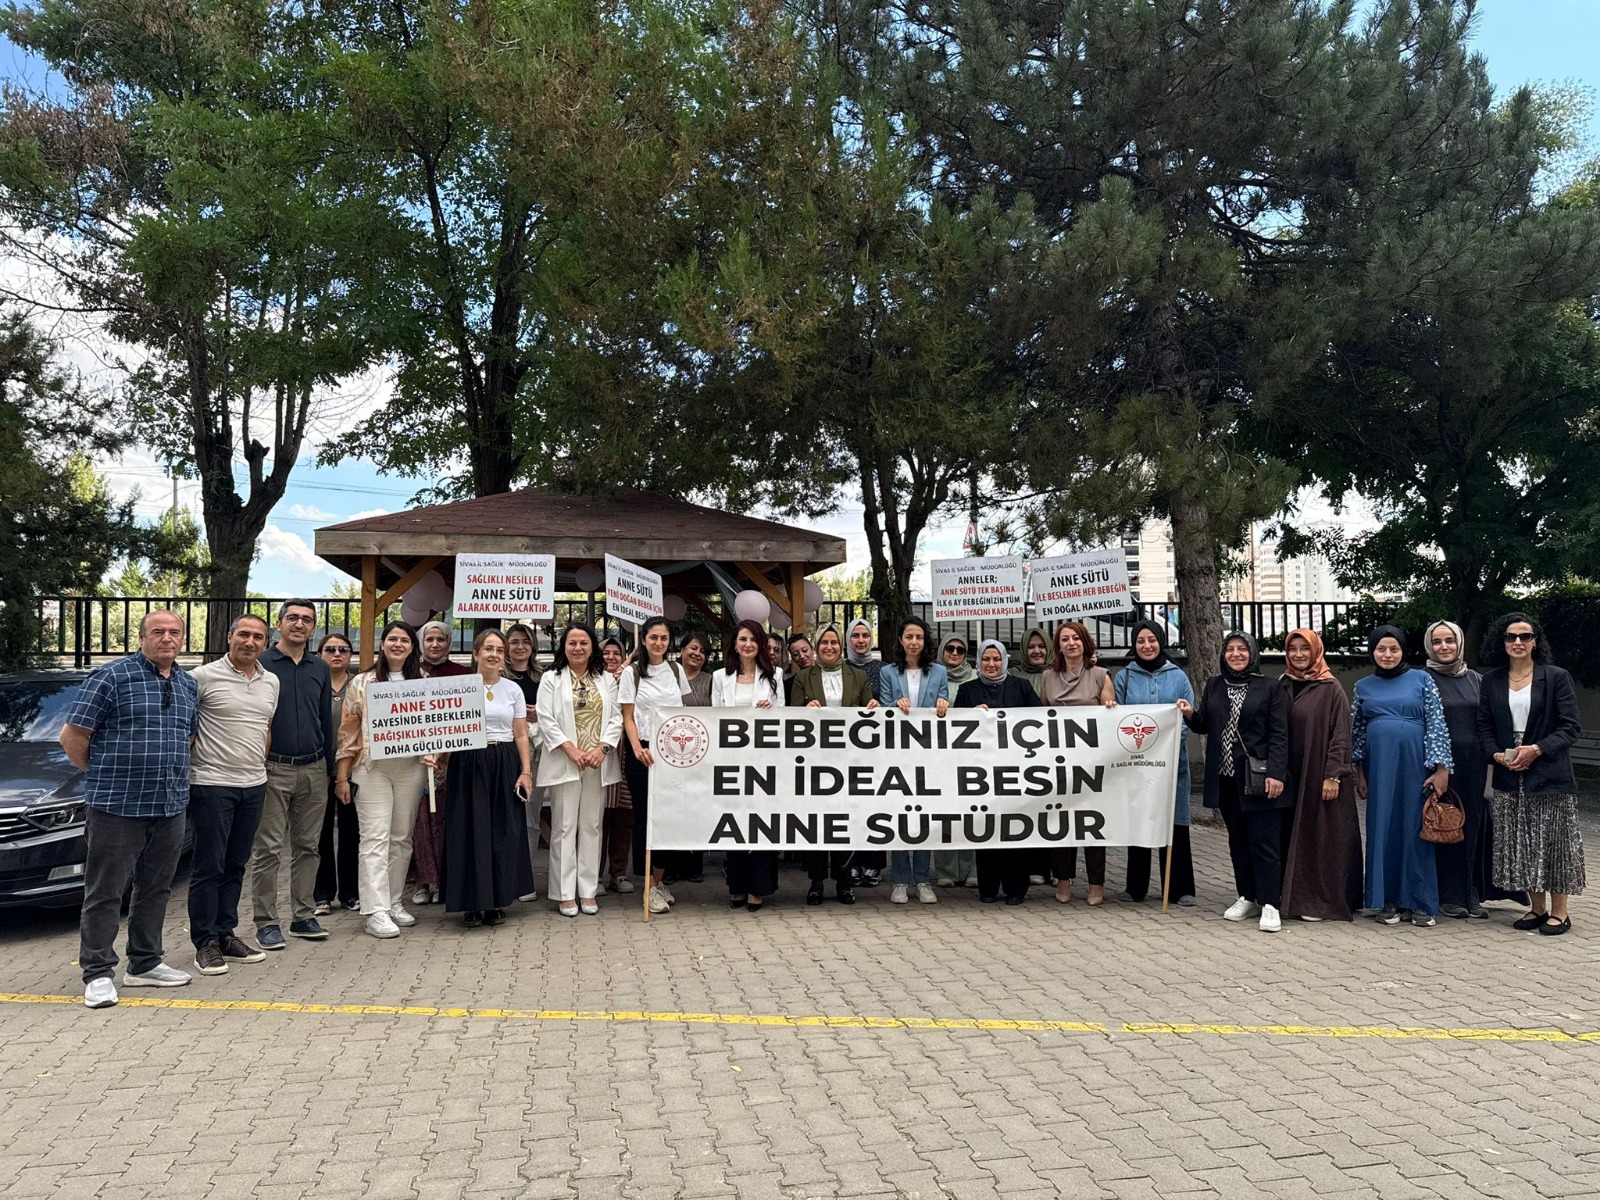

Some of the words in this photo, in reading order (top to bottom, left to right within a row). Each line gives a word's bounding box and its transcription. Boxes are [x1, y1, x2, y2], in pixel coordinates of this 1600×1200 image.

[467, 573, 503, 584] SAĞLIKLI
[506, 574, 544, 584] NESİLLER
[958, 575, 998, 584] ANNELER;
[1050, 575, 1080, 588] ANNE
[1081, 568, 1109, 584] SÜTÜ
[472, 588, 506, 600] ANNE
[509, 587, 540, 600] SÜTÜ
[618, 577, 635, 592] ANNE
[636, 583, 652, 598] SÜTÜ
[940, 588, 958, 596] ANNE
[960, 586, 976, 595] SÜTÜ
[990, 586, 1015, 594] BAŞINA
[1036, 592, 1046, 602] İLE
[1048, 589, 1081, 600] BESLENME
[1082, 587, 1096, 596] HER
[1098, 582, 1126, 594] BEBEĞİN
[607, 588, 619, 598] YENİ
[620, 593, 637, 604] DOĞAN
[638, 598, 652, 610] BEBEK
[936, 598, 947, 607] İLK
[962, 596, 1004, 606] BEBEĞİNİZİN
[1006, 595, 1020, 604] TÜM
[1042, 607, 1053, 616] EN
[1054, 603, 1080, 614] DOĞAL
[1082, 598, 1124, 611] HAKKIDIR.
[458, 603, 490, 612] ALARAK
[492, 603, 550, 614] OLUŞACAKTIR.
[612, 602, 619, 612] EN
[620, 604, 634, 617] İDEAL
[936, 608, 954, 618] BESİN
[956, 608, 990, 616] İHTİYACINI
[992, 607, 1024, 616] KARŞILAR
[373, 692, 393, 700] SİVAS
[402, 690, 426, 698] SAĞLIK
[432, 686, 476, 696] MÜDÜRLÜĞÜ
[390, 700, 426, 714] ANNE
[372, 715, 422, 728] SAYESİNDE
[425, 708, 482, 724] BEBEKLERİN
[373, 728, 426, 742] BAĞIŞIKLIK
[428, 721, 482, 736] SİSTEMLERİ
[719, 710, 981, 749] BEBEĞİNİZ
[997, 709, 1099, 758] İÇİN
[384, 744, 410, 755] DAHA
[412, 739, 443, 753] GÜÇLÜ
[445, 738, 473, 748] OLUR.
[713, 765, 776, 796] EN
[794, 756, 941, 796] İDEAL
[957, 755, 1105, 796] BESİN
[708, 812, 850, 844] ANNE
[866, 802, 1106, 844] SÜTÜDÜR
